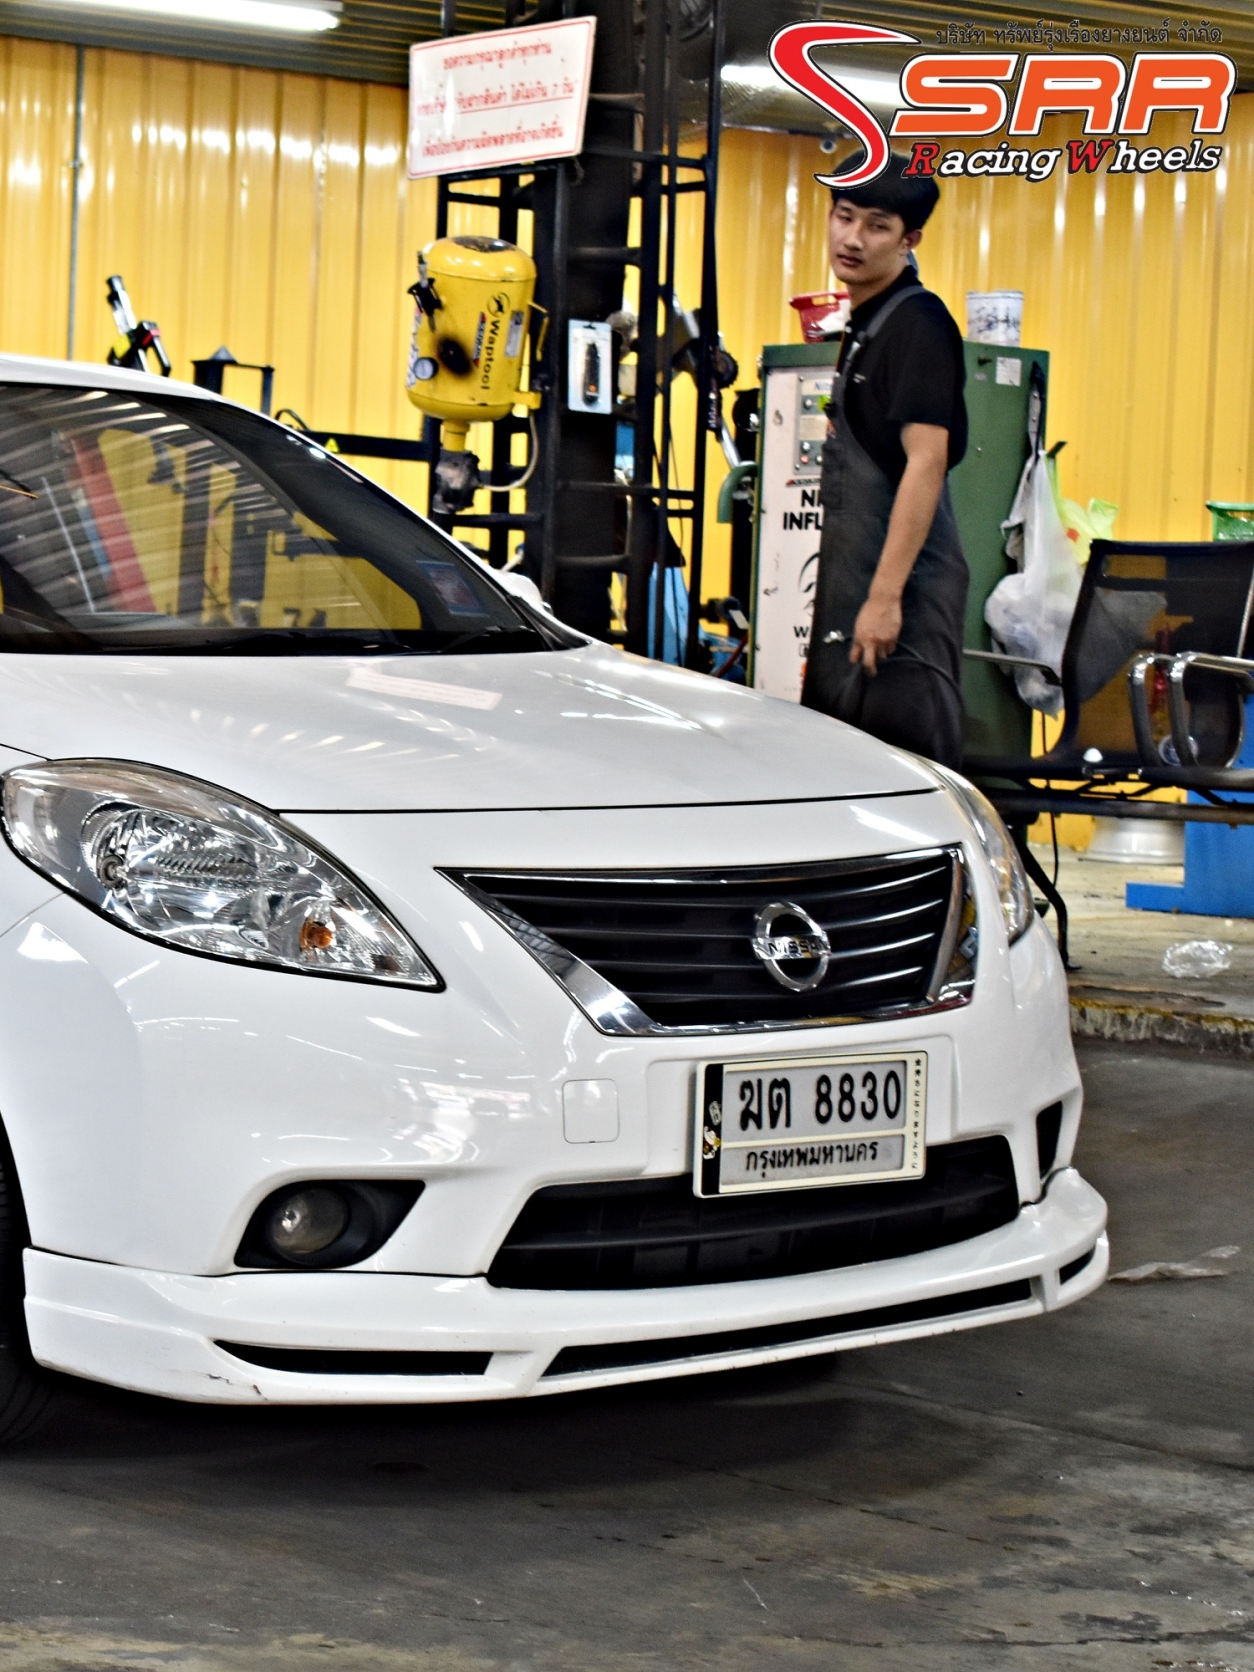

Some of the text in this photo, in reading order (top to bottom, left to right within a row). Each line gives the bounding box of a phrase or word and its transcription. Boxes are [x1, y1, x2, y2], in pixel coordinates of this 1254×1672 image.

[480, 319, 501, 390] Waptool
[740, 1078, 791, 1131] ฆต
[815, 1070, 902, 1125] 8830
[746, 1141, 878, 1178] กรุงเทพมหานคร
